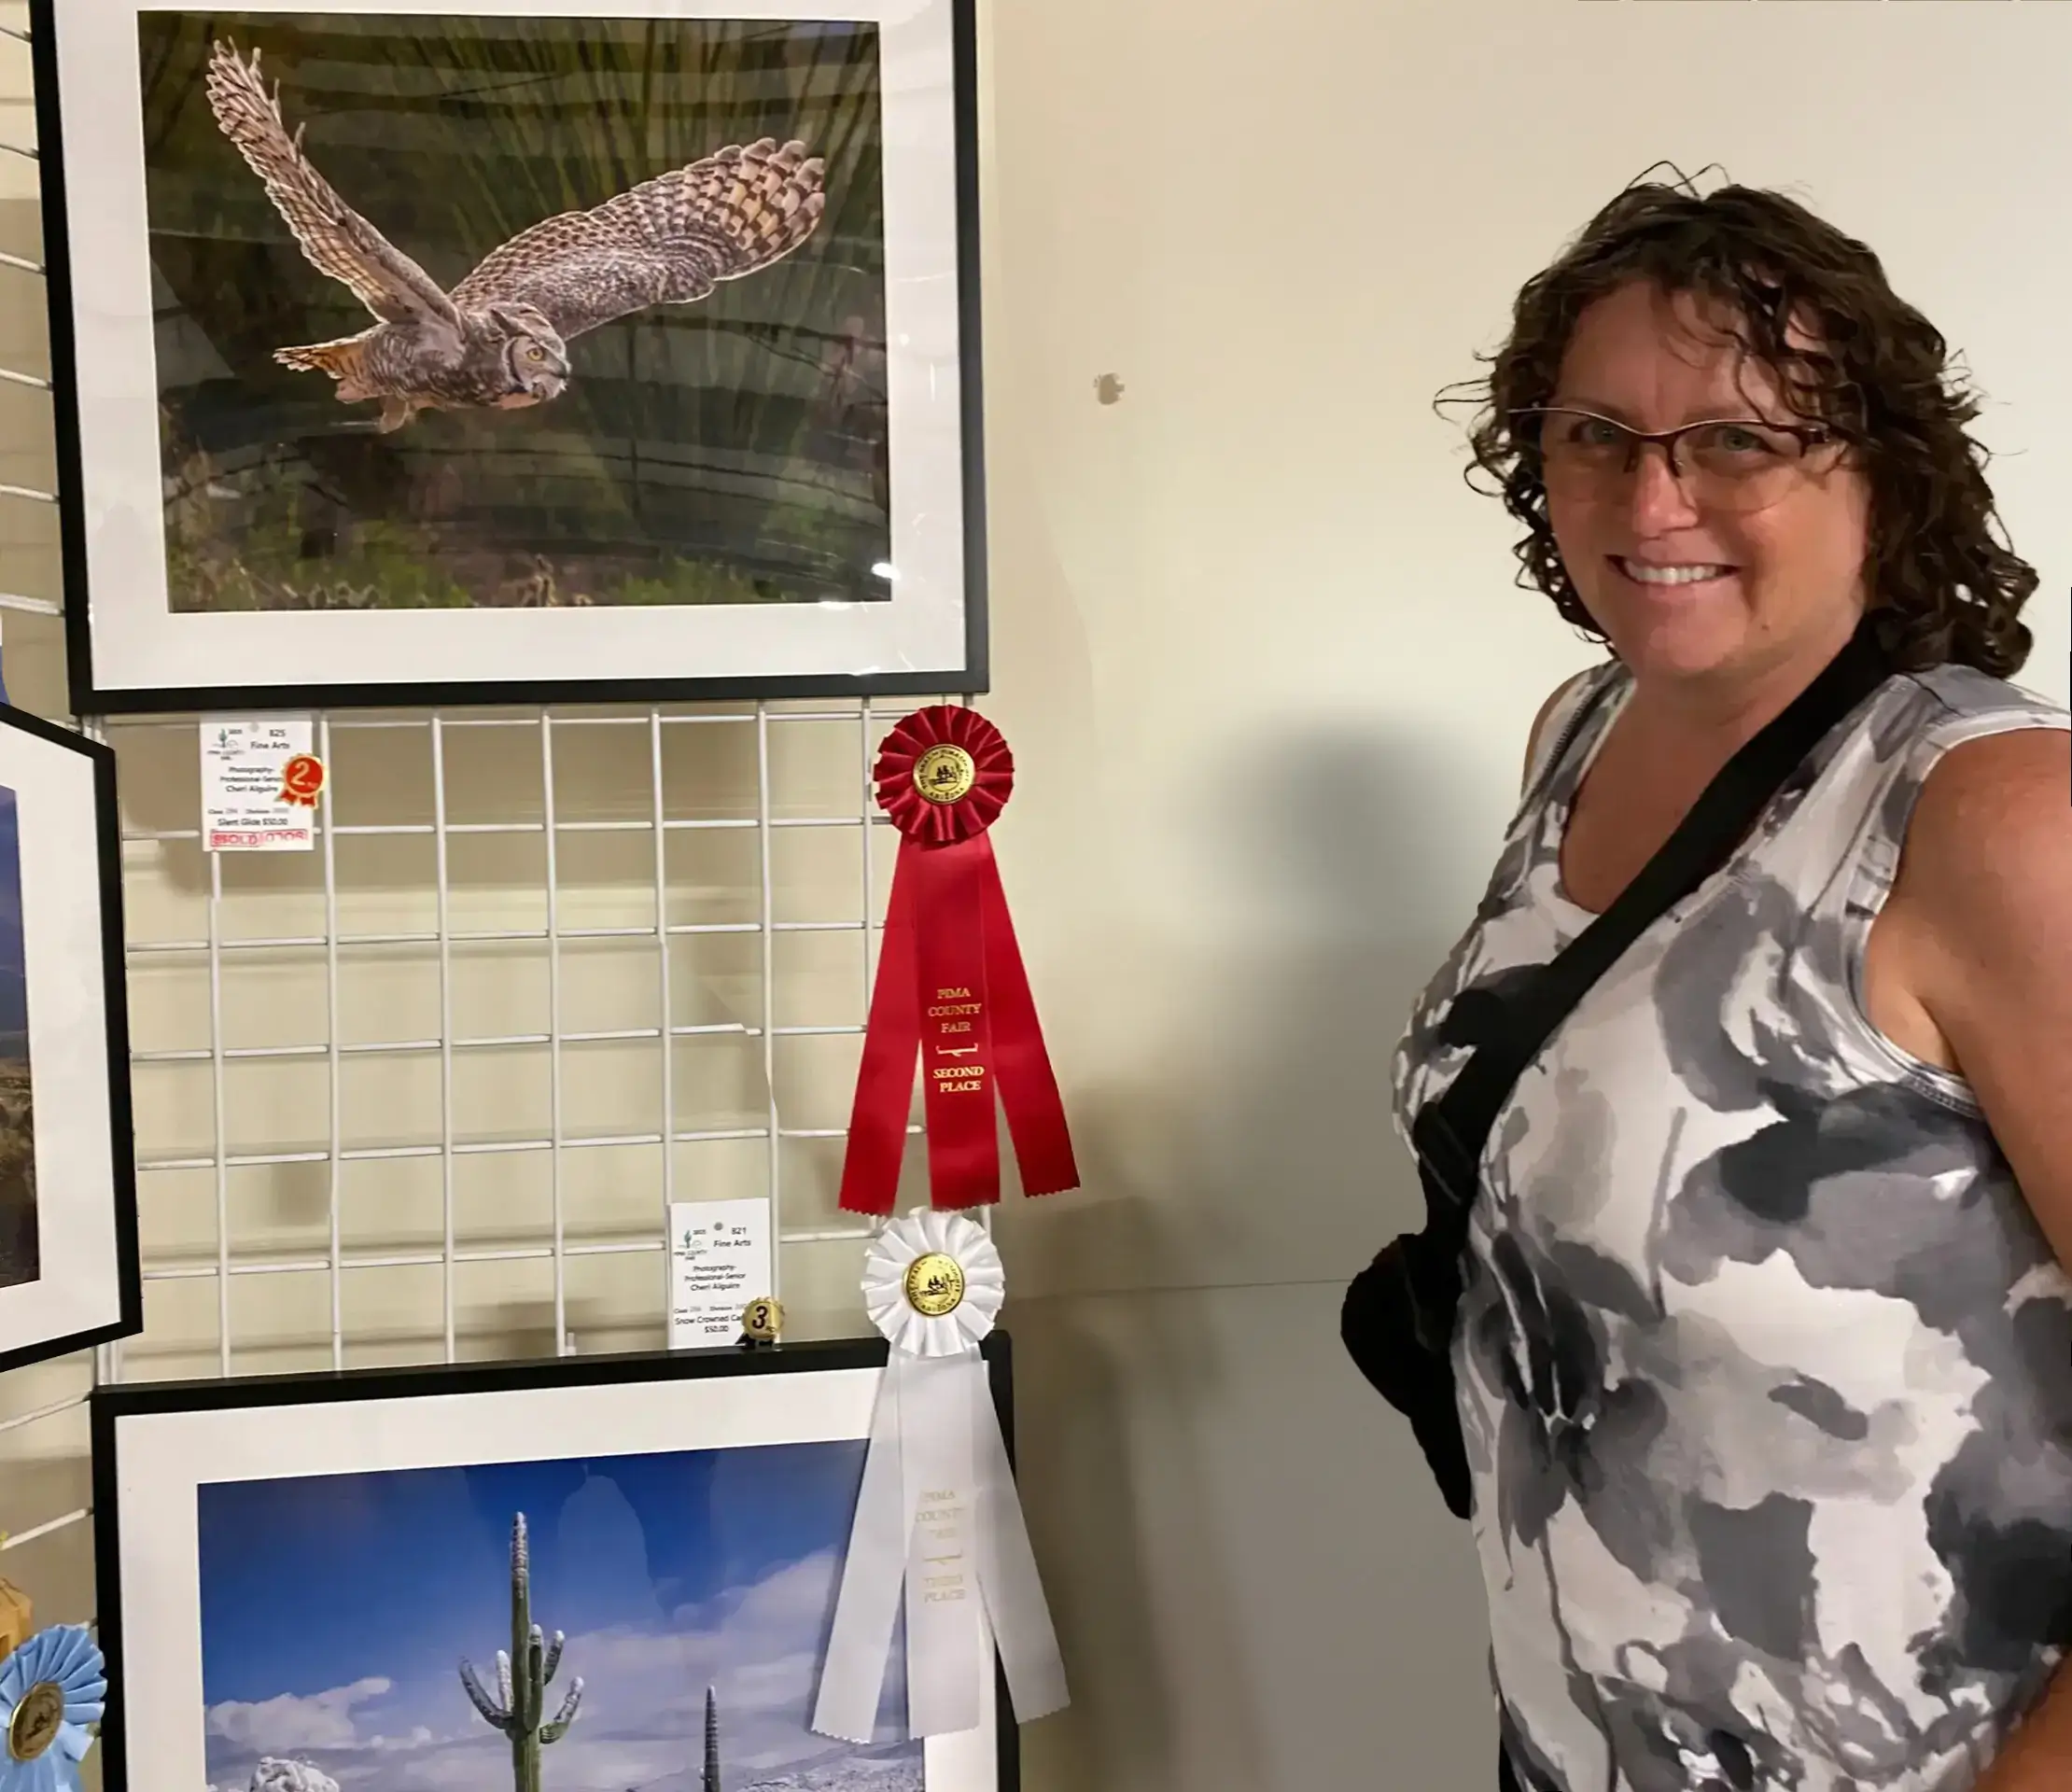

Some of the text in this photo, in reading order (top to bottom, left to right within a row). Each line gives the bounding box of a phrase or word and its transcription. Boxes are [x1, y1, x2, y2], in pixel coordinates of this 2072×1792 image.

[250, 741, 290, 749] Fine Arts
[291, 761, 309, 786] 2
[937, 987, 971, 999] PIMA
[928, 1003, 982, 1016] COUNTY
[941, 1022, 972, 1033] FAIR
[933, 1066, 985, 1079] SECOND
[940, 1081, 981, 1092] PLACE
[713, 1239, 752, 1248] Fine Arts
[752, 1306, 767, 1329] 3
